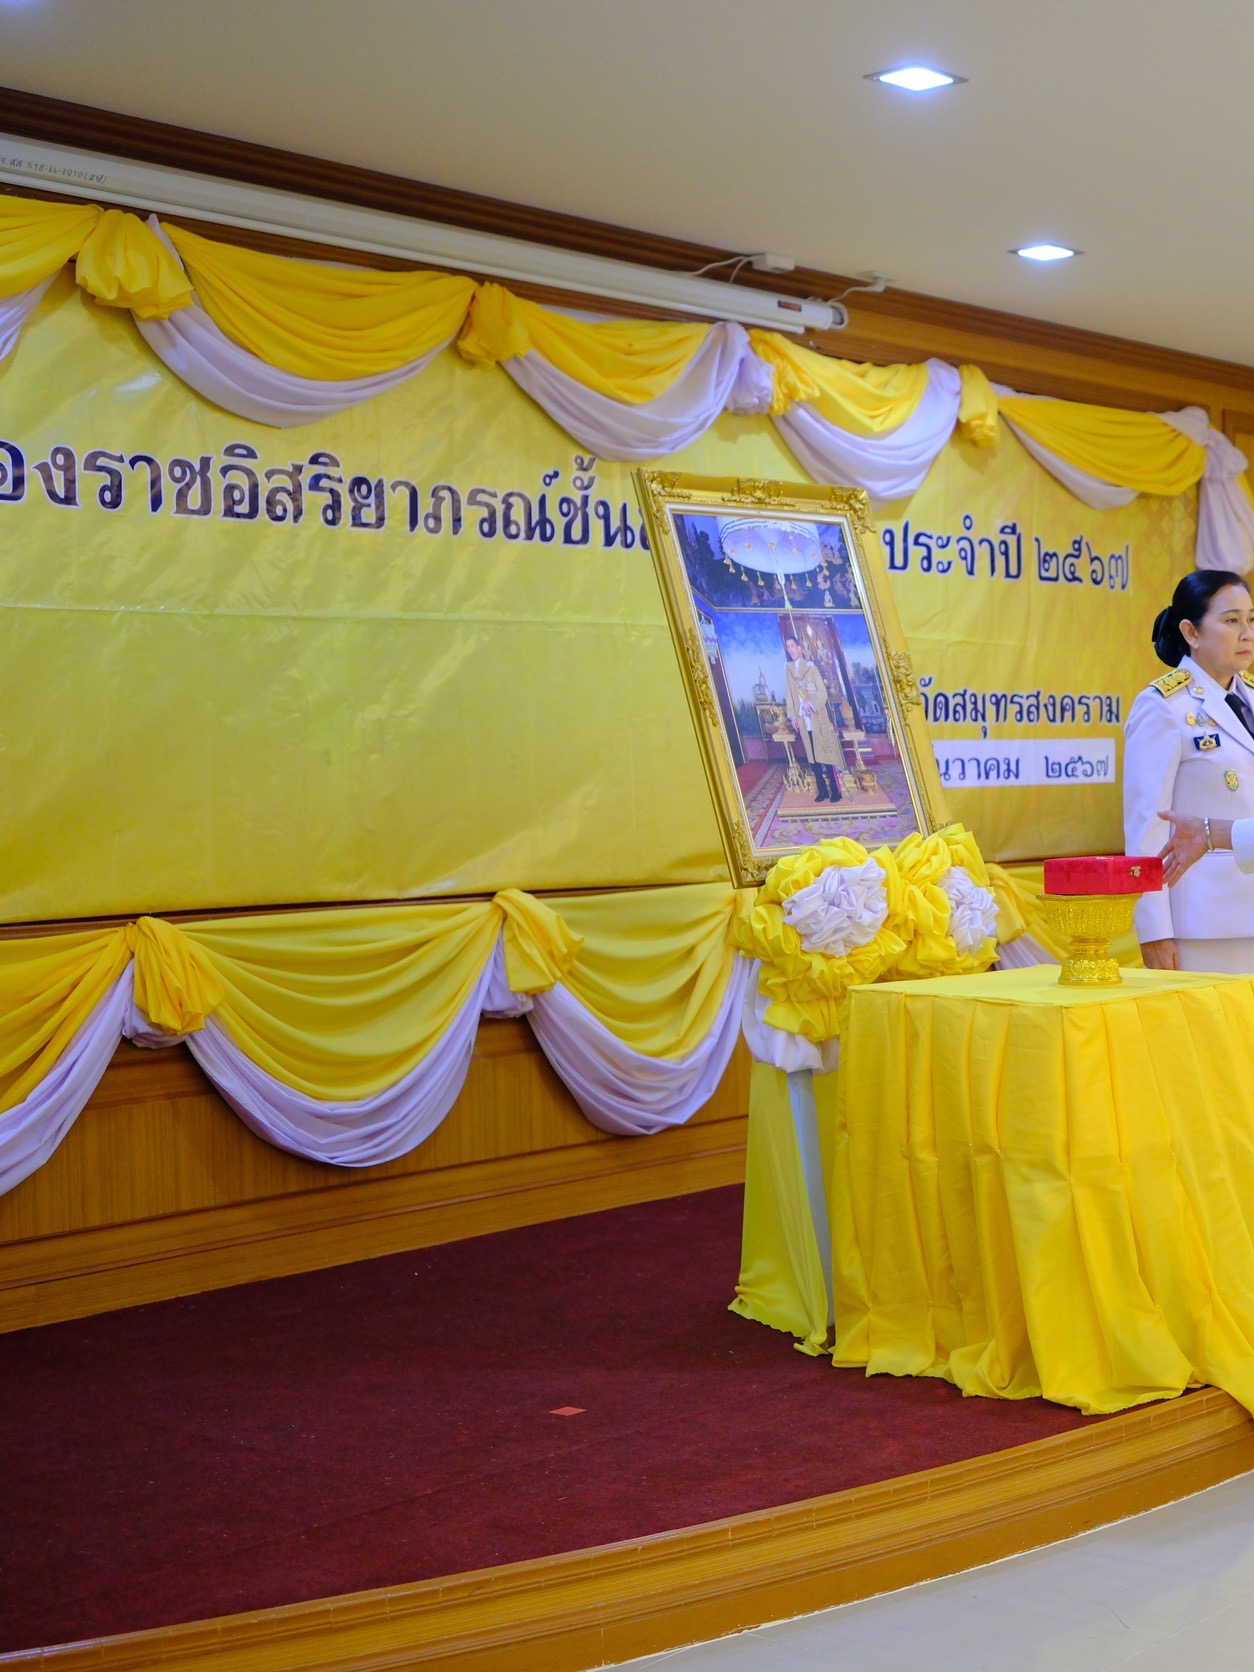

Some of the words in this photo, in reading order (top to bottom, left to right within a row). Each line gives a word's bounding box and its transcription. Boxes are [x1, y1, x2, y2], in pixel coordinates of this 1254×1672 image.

[0, 441, 650, 551] องราชอิสริยาภรณ์ชั้น
[882, 513, 1022, 580] ประจำปี
[1034, 533, 1130, 591] ๒๕๖๗
[934, 755, 1020, 782] นวาคม
[1044, 754, 1109, 778] ๒๕๖๗
